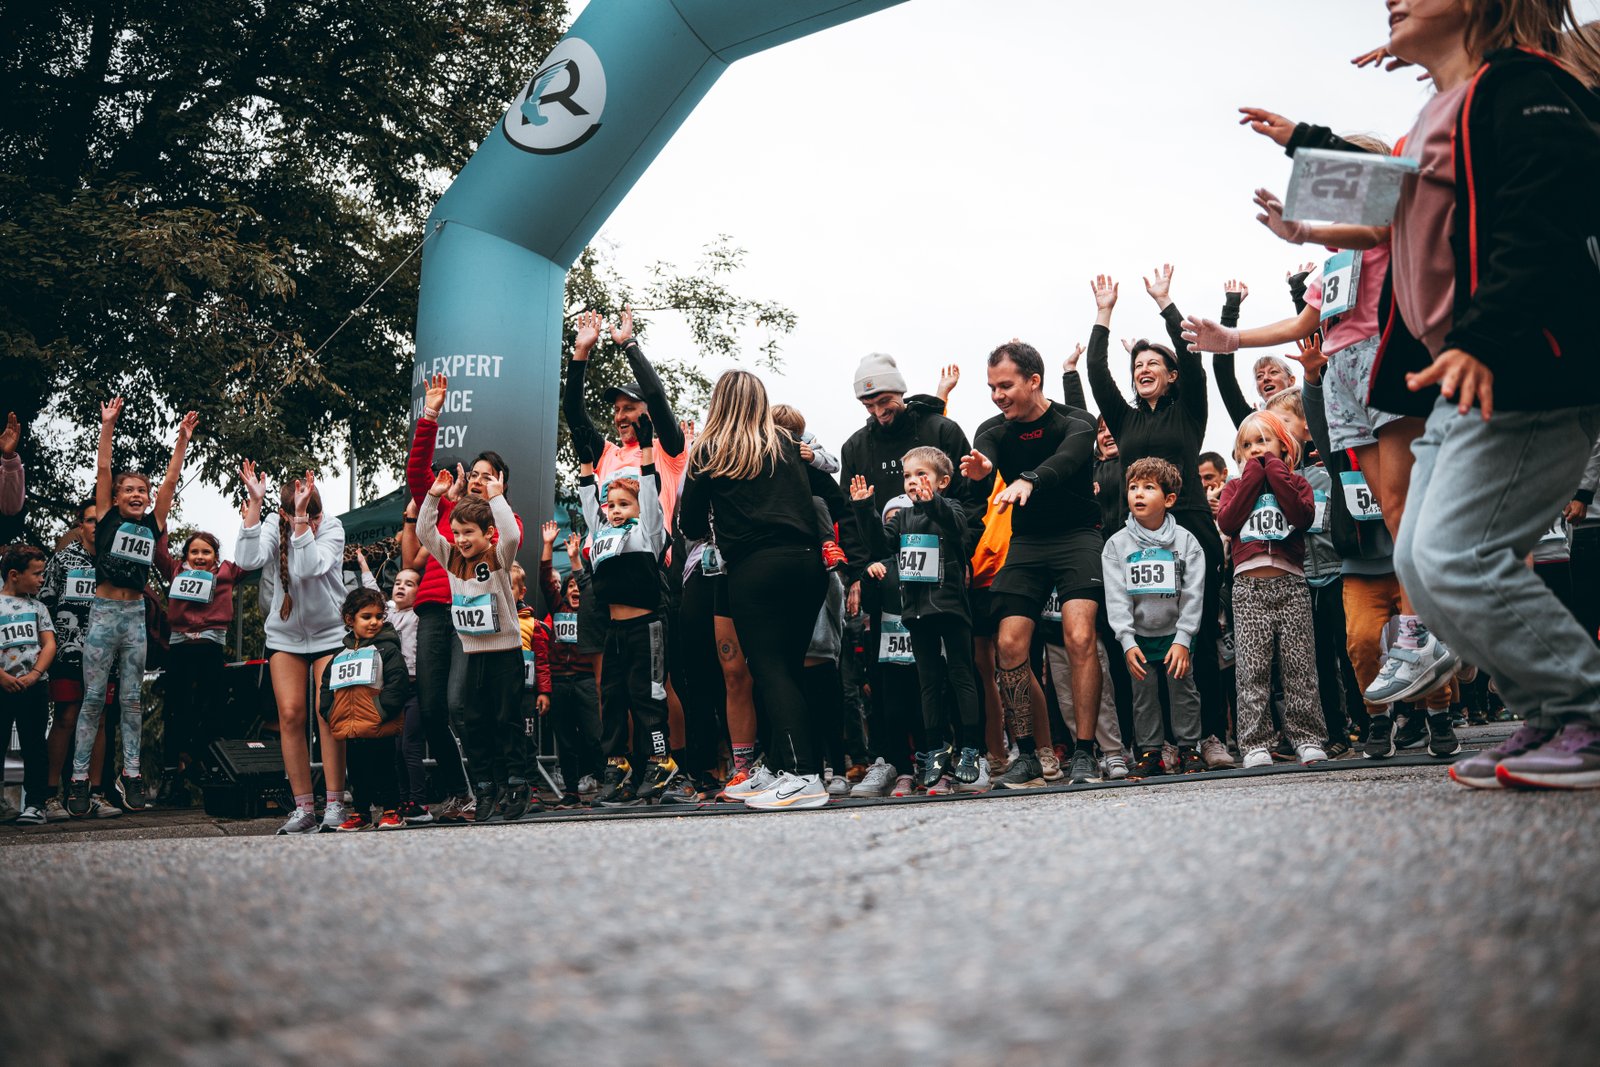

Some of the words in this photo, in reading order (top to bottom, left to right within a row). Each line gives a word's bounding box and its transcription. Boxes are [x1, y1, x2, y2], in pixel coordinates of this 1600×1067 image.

[413, 355, 504, 388] UN-EXPERT
[413, 390, 474, 421] VANCE
[435, 425, 469, 449] ECY
[1249, 510, 1284, 531] 1138
[121, 536, 151, 557] 1145
[900, 551, 927, 571] 547
[477, 562, 490, 583] S
[1130, 564, 1165, 584] 553
[179, 579, 203, 594] 527
[455, 609, 486, 627] 1142
[1, 623, 34, 641] 1146
[556, 623, 578, 636] 108
[338, 662, 362, 680] 551
